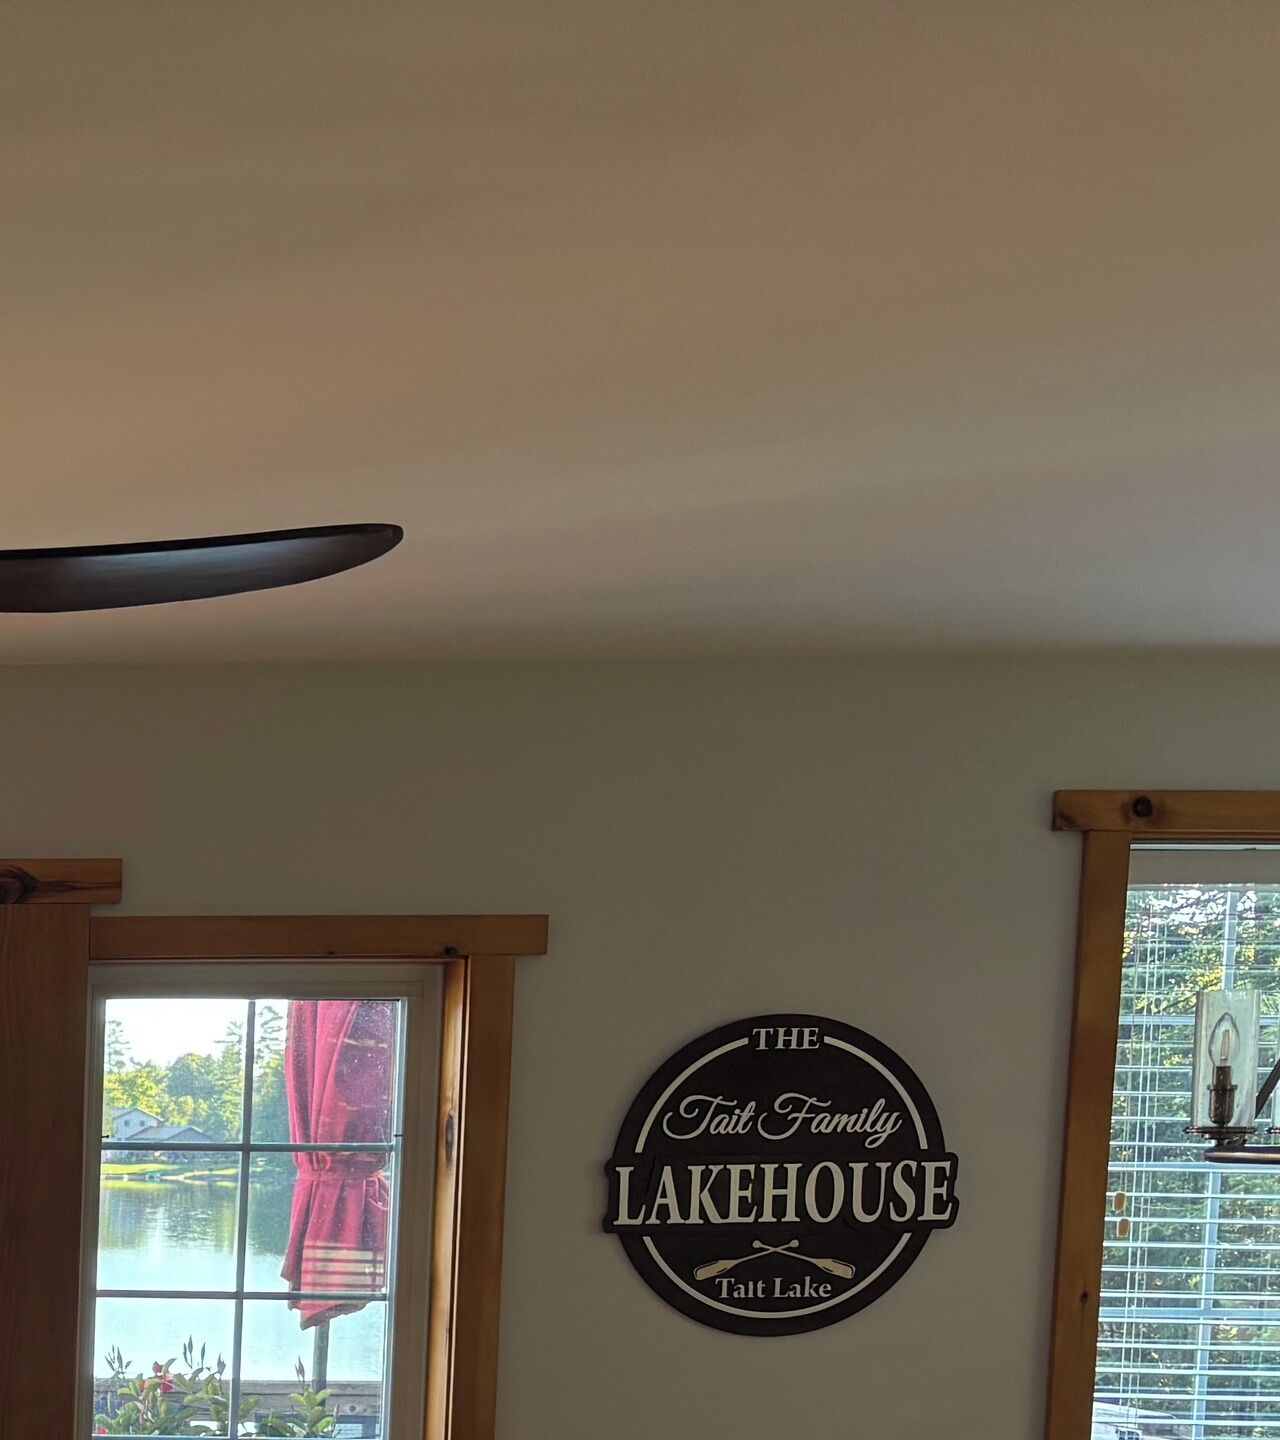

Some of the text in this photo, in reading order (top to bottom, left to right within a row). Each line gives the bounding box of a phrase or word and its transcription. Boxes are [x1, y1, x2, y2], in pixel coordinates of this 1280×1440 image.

[752, 1027, 820, 1050] THE
[662, 1092, 903, 1149] Tait Family
[612, 1159, 954, 1226] LAKEHOUSE
[715, 1276, 832, 1298] Tait Lake
